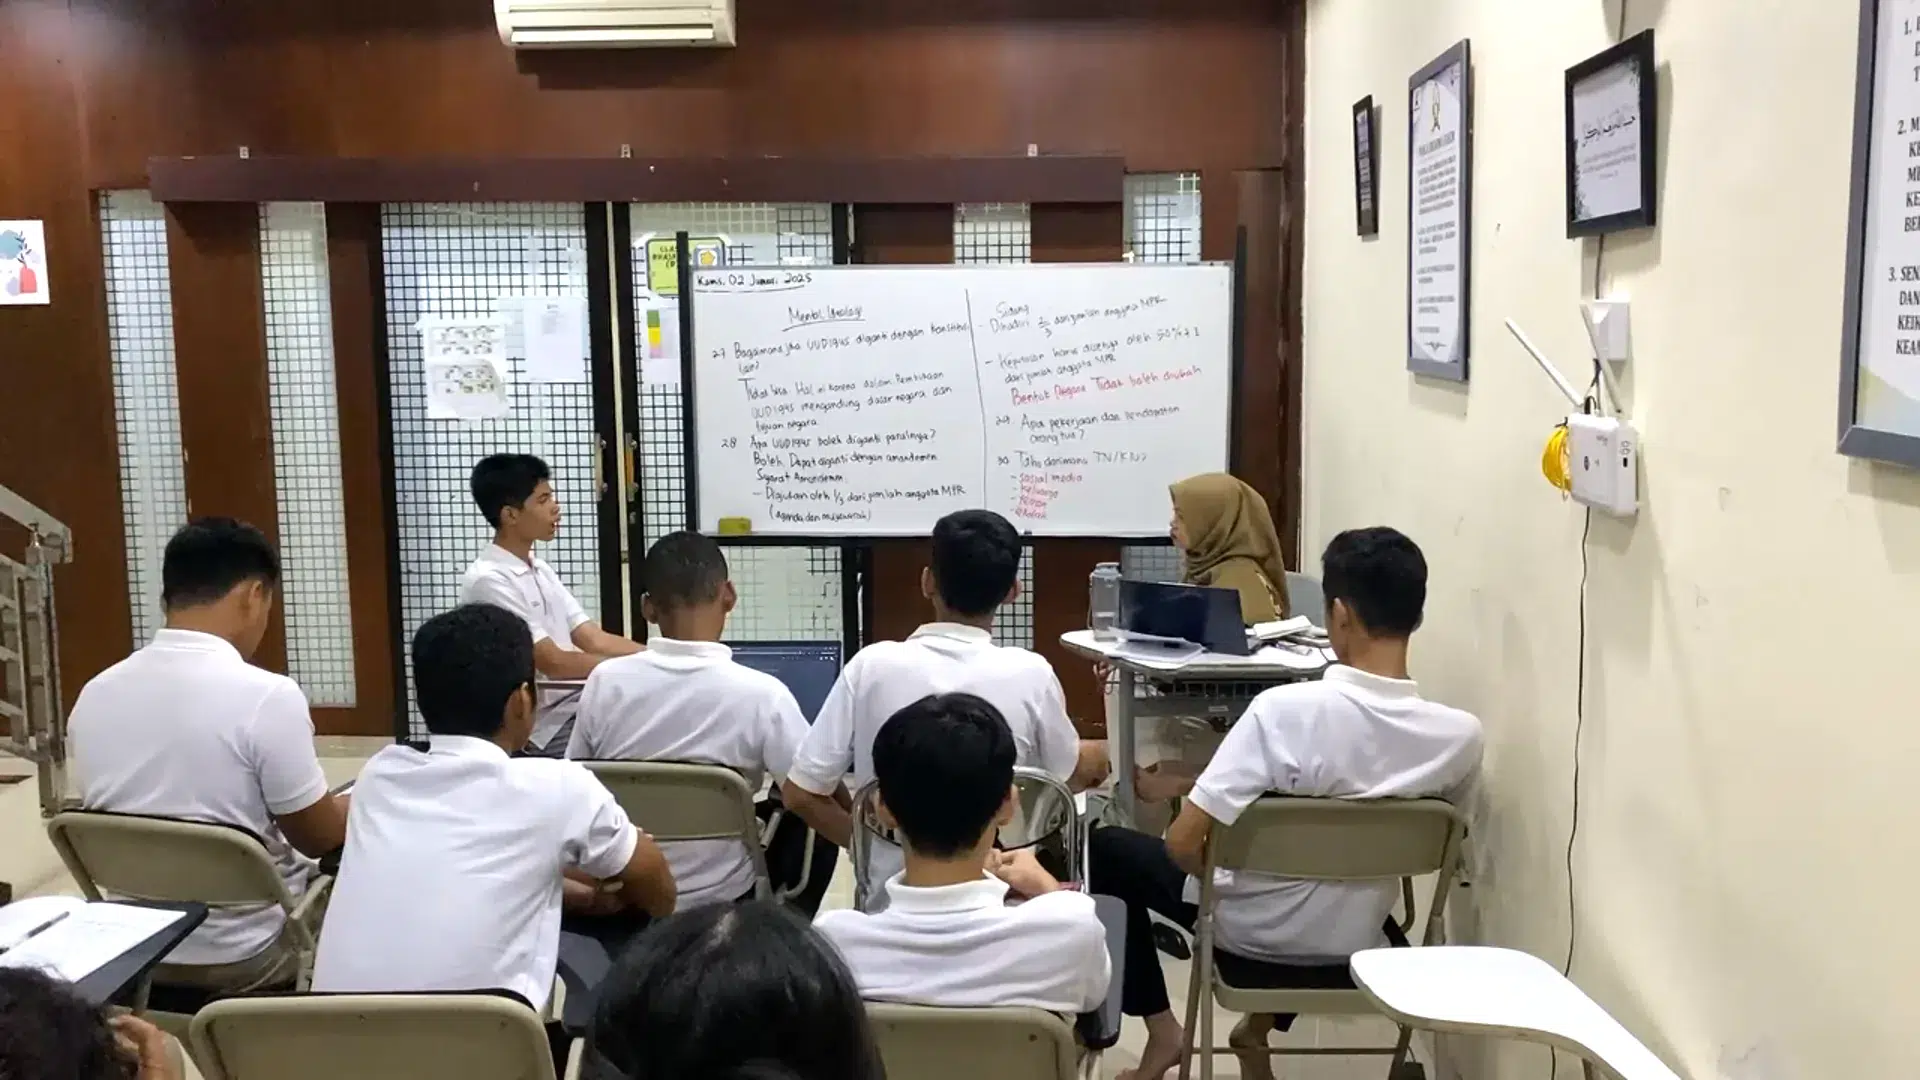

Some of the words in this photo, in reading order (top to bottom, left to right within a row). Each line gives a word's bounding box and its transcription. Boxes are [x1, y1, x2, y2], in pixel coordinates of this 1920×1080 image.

[729, 273, 745, 287] 02
[784, 272, 813, 285] 2025
[712, 348, 726, 360] 27
[891, 329, 925, 342] dengan
[1126, 332, 1151, 346] oleh
[801, 398, 861, 413] mengandung
[895, 390, 926, 405] negara
[932, 386, 953, 397] dan
[995, 415, 1010, 426] 29
[1021, 412, 1046, 432] Apa
[1100, 411, 1121, 422] dan
[721, 436, 738, 449] 28
[750, 434, 769, 451] Apa
[789, 452, 817, 469] Dapat
[850, 451, 883, 466] dengan
[904, 487, 940, 502] anggota
[941, 484, 967, 497] MPR
